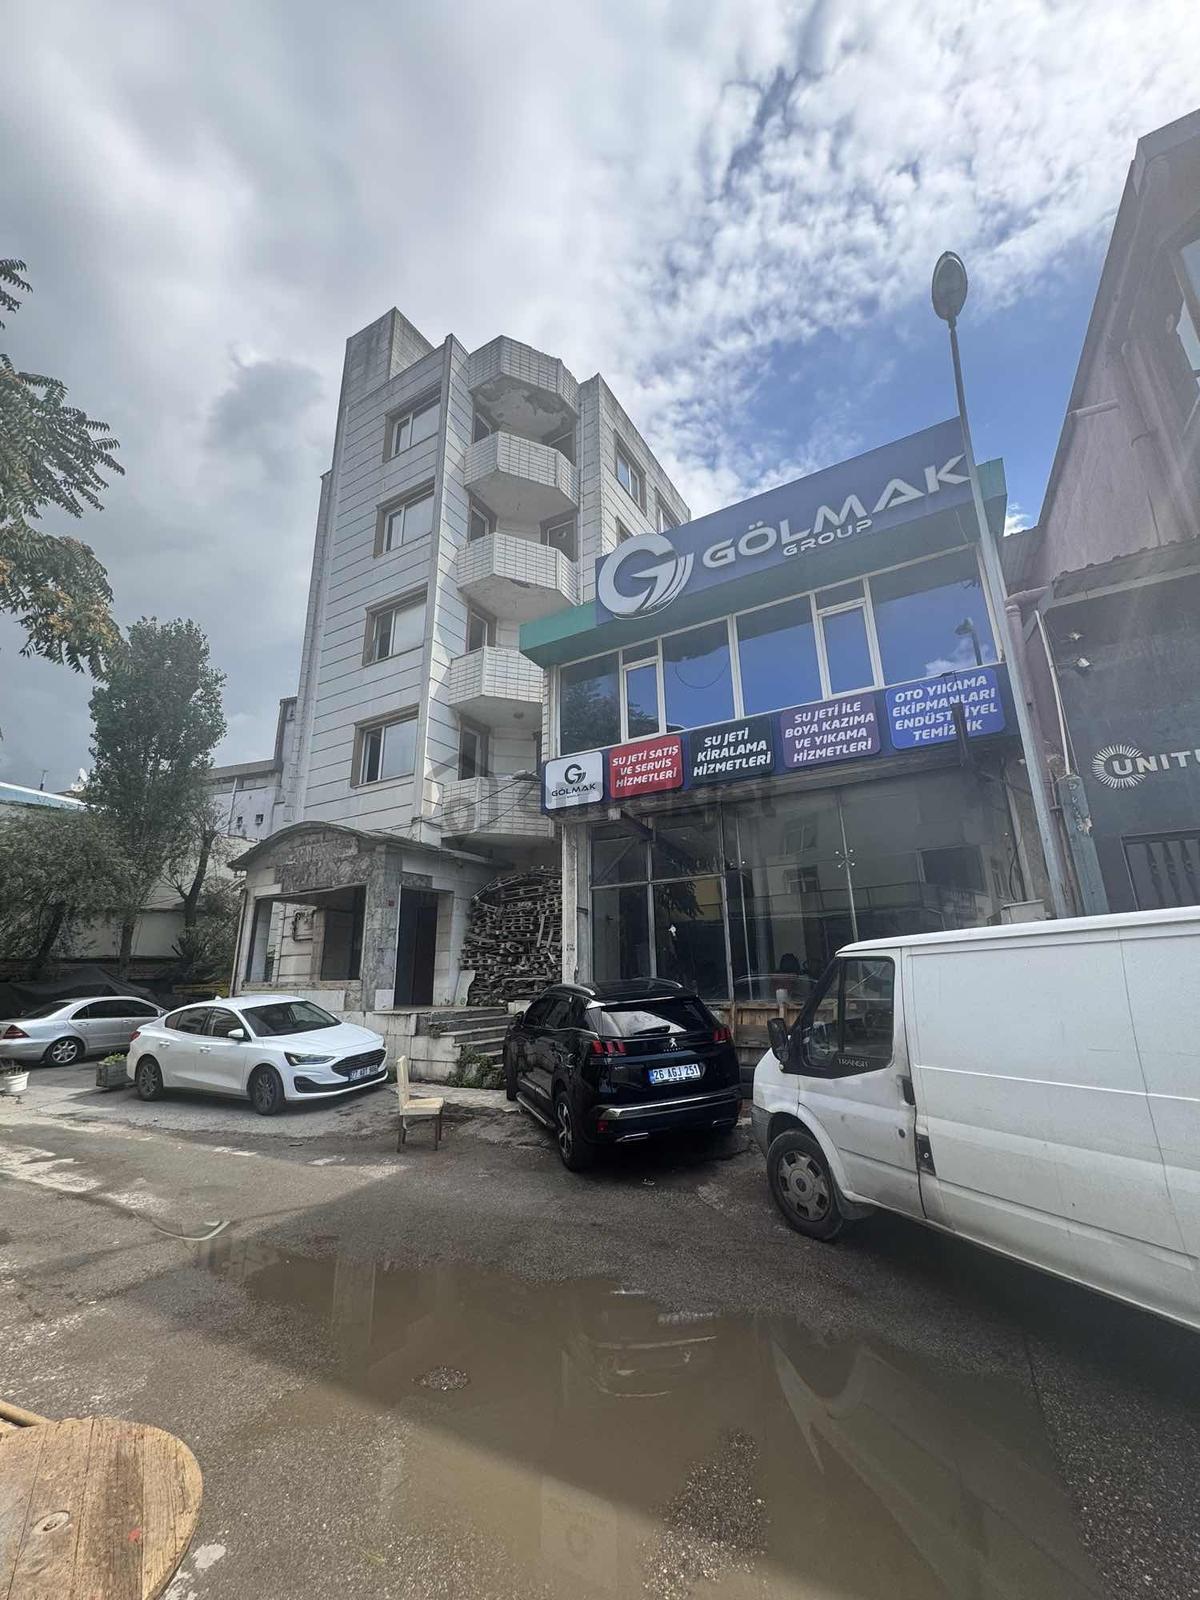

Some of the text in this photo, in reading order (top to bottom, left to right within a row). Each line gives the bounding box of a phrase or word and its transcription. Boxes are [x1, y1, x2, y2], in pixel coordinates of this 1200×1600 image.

[702, 454, 971, 568] GÖLMAK
[783, 519, 873, 557] GROUP
[895, 675, 988, 703] OTO YIKAMA
[794, 701, 861, 724] SU JETİ İLE
[892, 687, 996, 717] EKİPMANLARI
[784, 712, 875, 739] BOYA KAZIMA
[895, 702, 998, 730] ENDÜSTİYEL
[704, 727, 749, 748] SU JETİ
[795, 727, 868, 749] VE YIKAMA
[912, 719, 983, 741] TEMİZİK
[612, 745, 679, 767] SU JETİ SATIŞ
[697, 740, 767, 763] KİRALAMA
[793, 737, 872, 763] HİZMETLERİ
[1112, 749, 1200, 775] UNIT
[620, 758, 672, 776] VE SERVİS
[693, 751, 771, 777] HİZMETLERİ
[616, 767, 677, 788] HİZMETLERİ
[653, 1069, 664, 1080] 26
[667, 1066, 682, 1078] AGJ
[683, 1064, 699, 1076] 251
